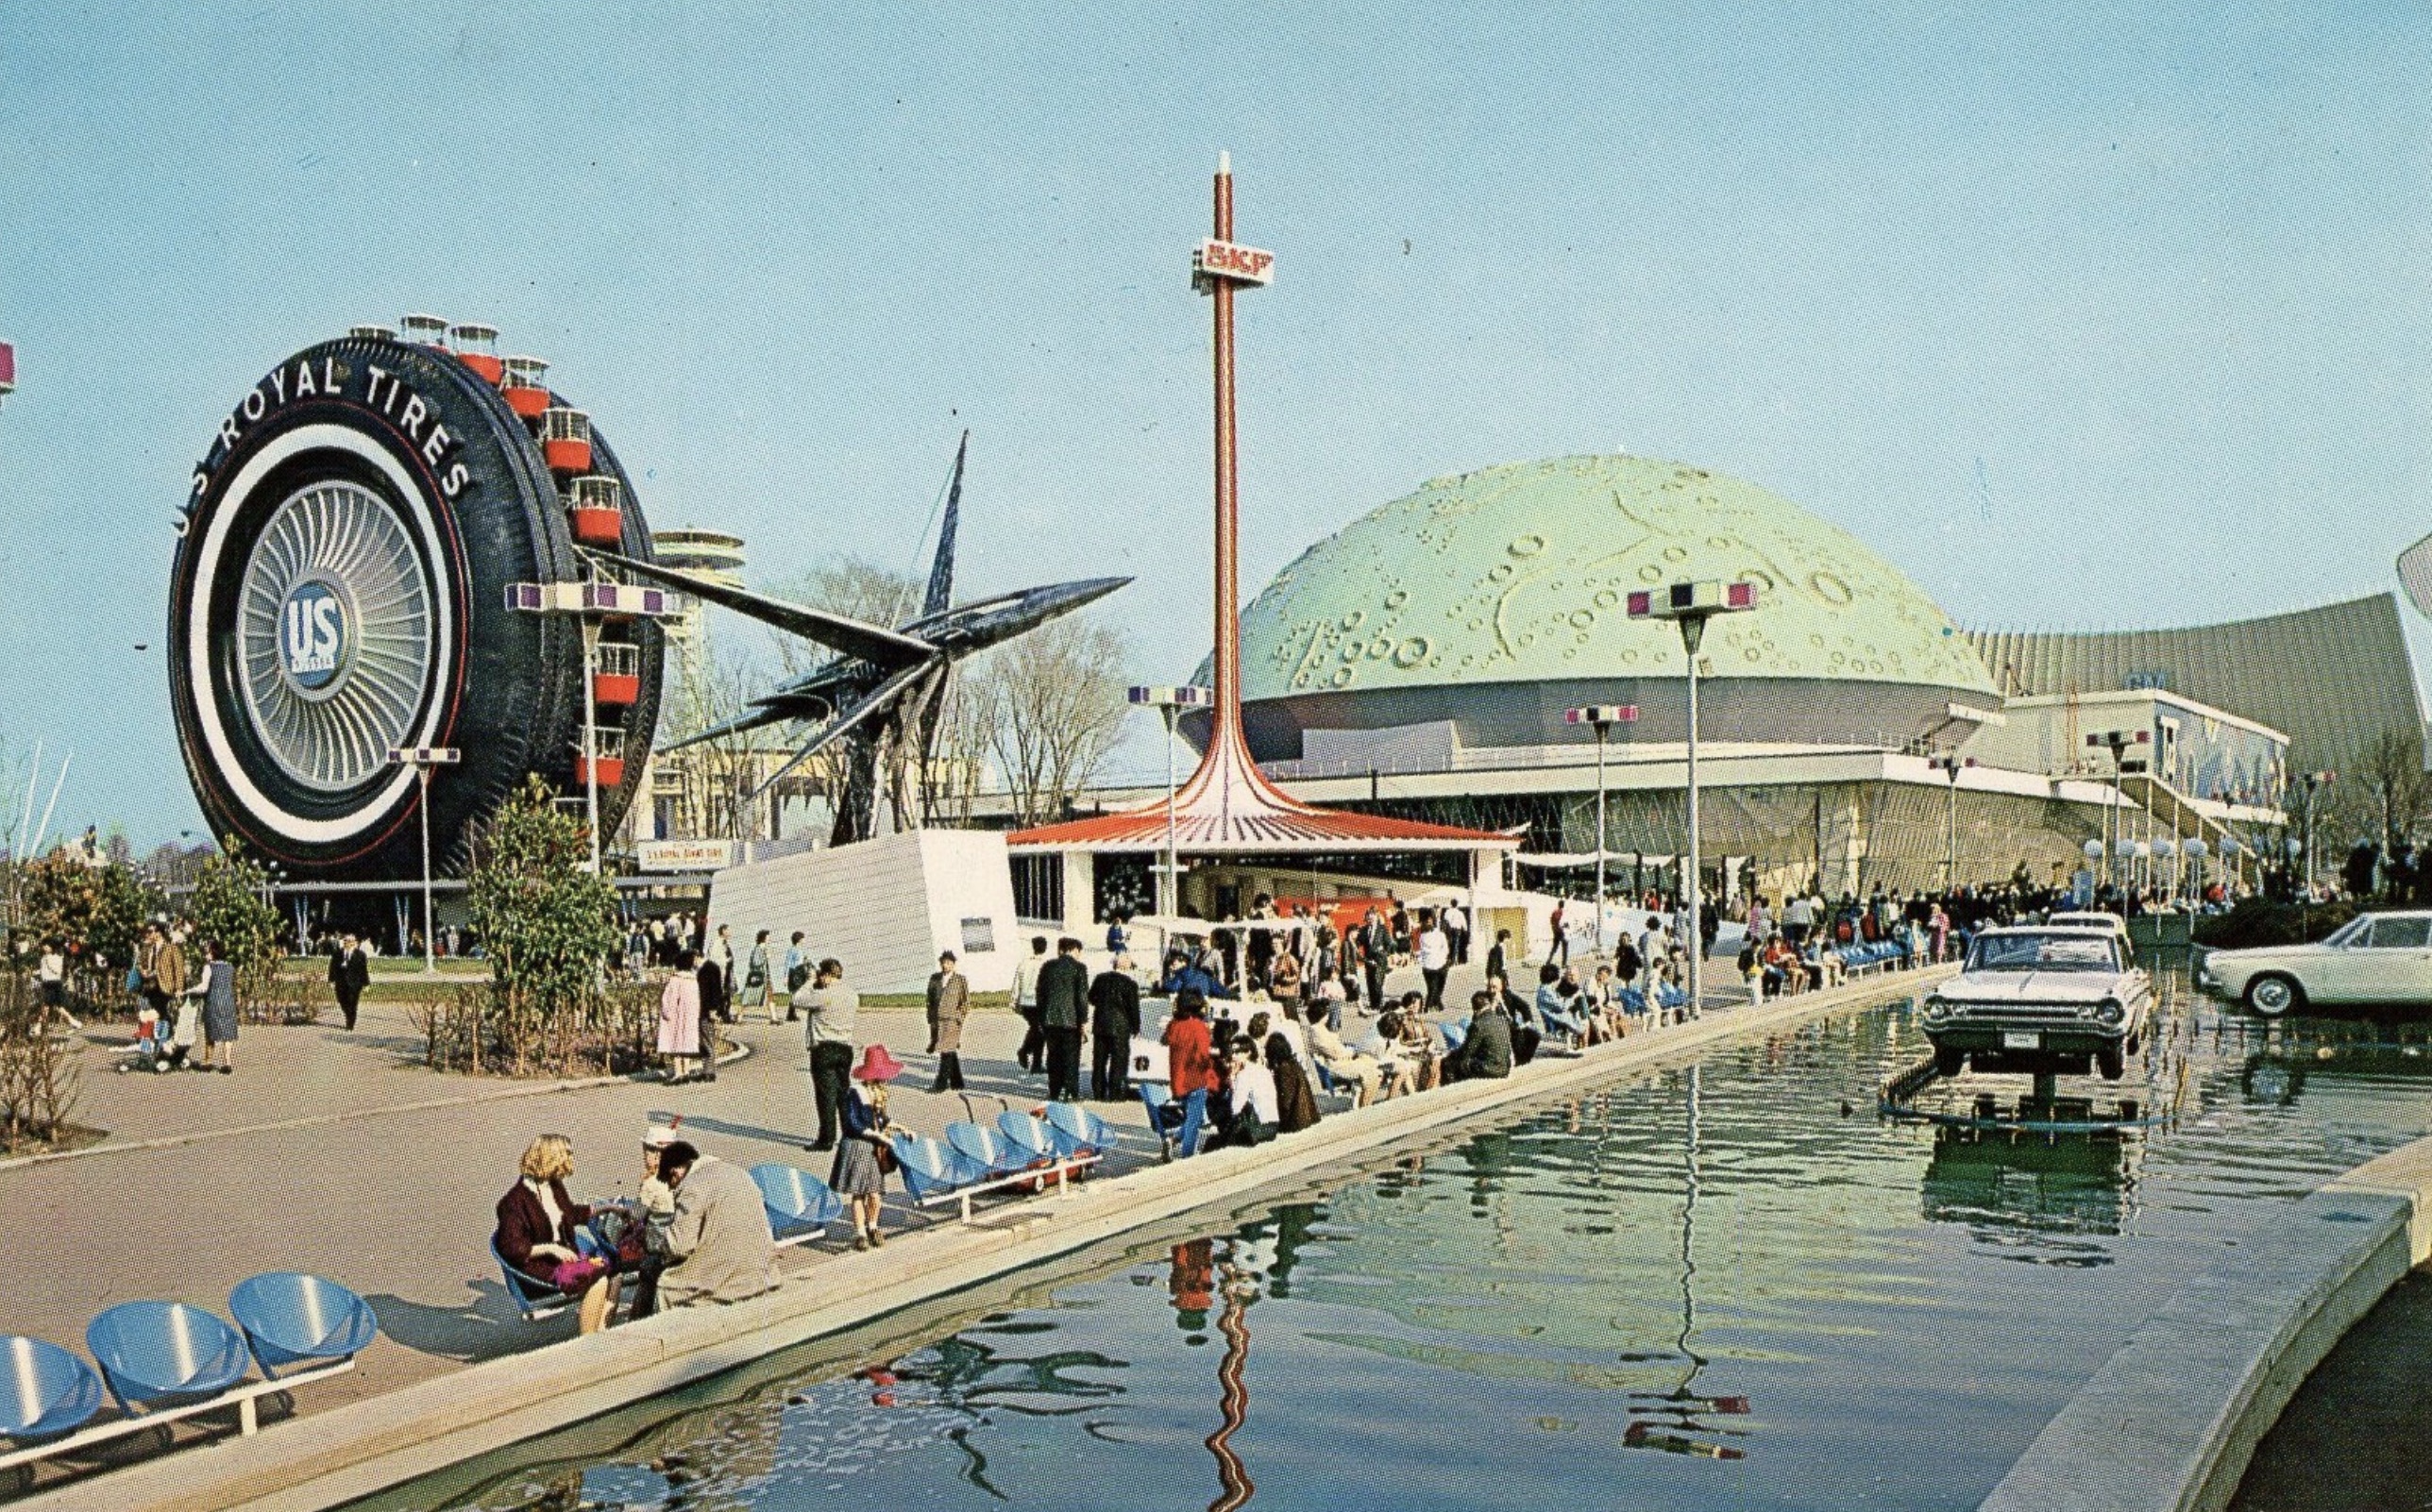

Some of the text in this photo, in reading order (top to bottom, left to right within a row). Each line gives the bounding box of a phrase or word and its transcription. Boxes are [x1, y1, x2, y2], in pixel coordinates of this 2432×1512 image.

[1207, 244, 1274, 276] SKF
[219, 357, 342, 450] ROYAL
[365, 364, 469, 496] TIRES
[288, 596, 338, 659] US
